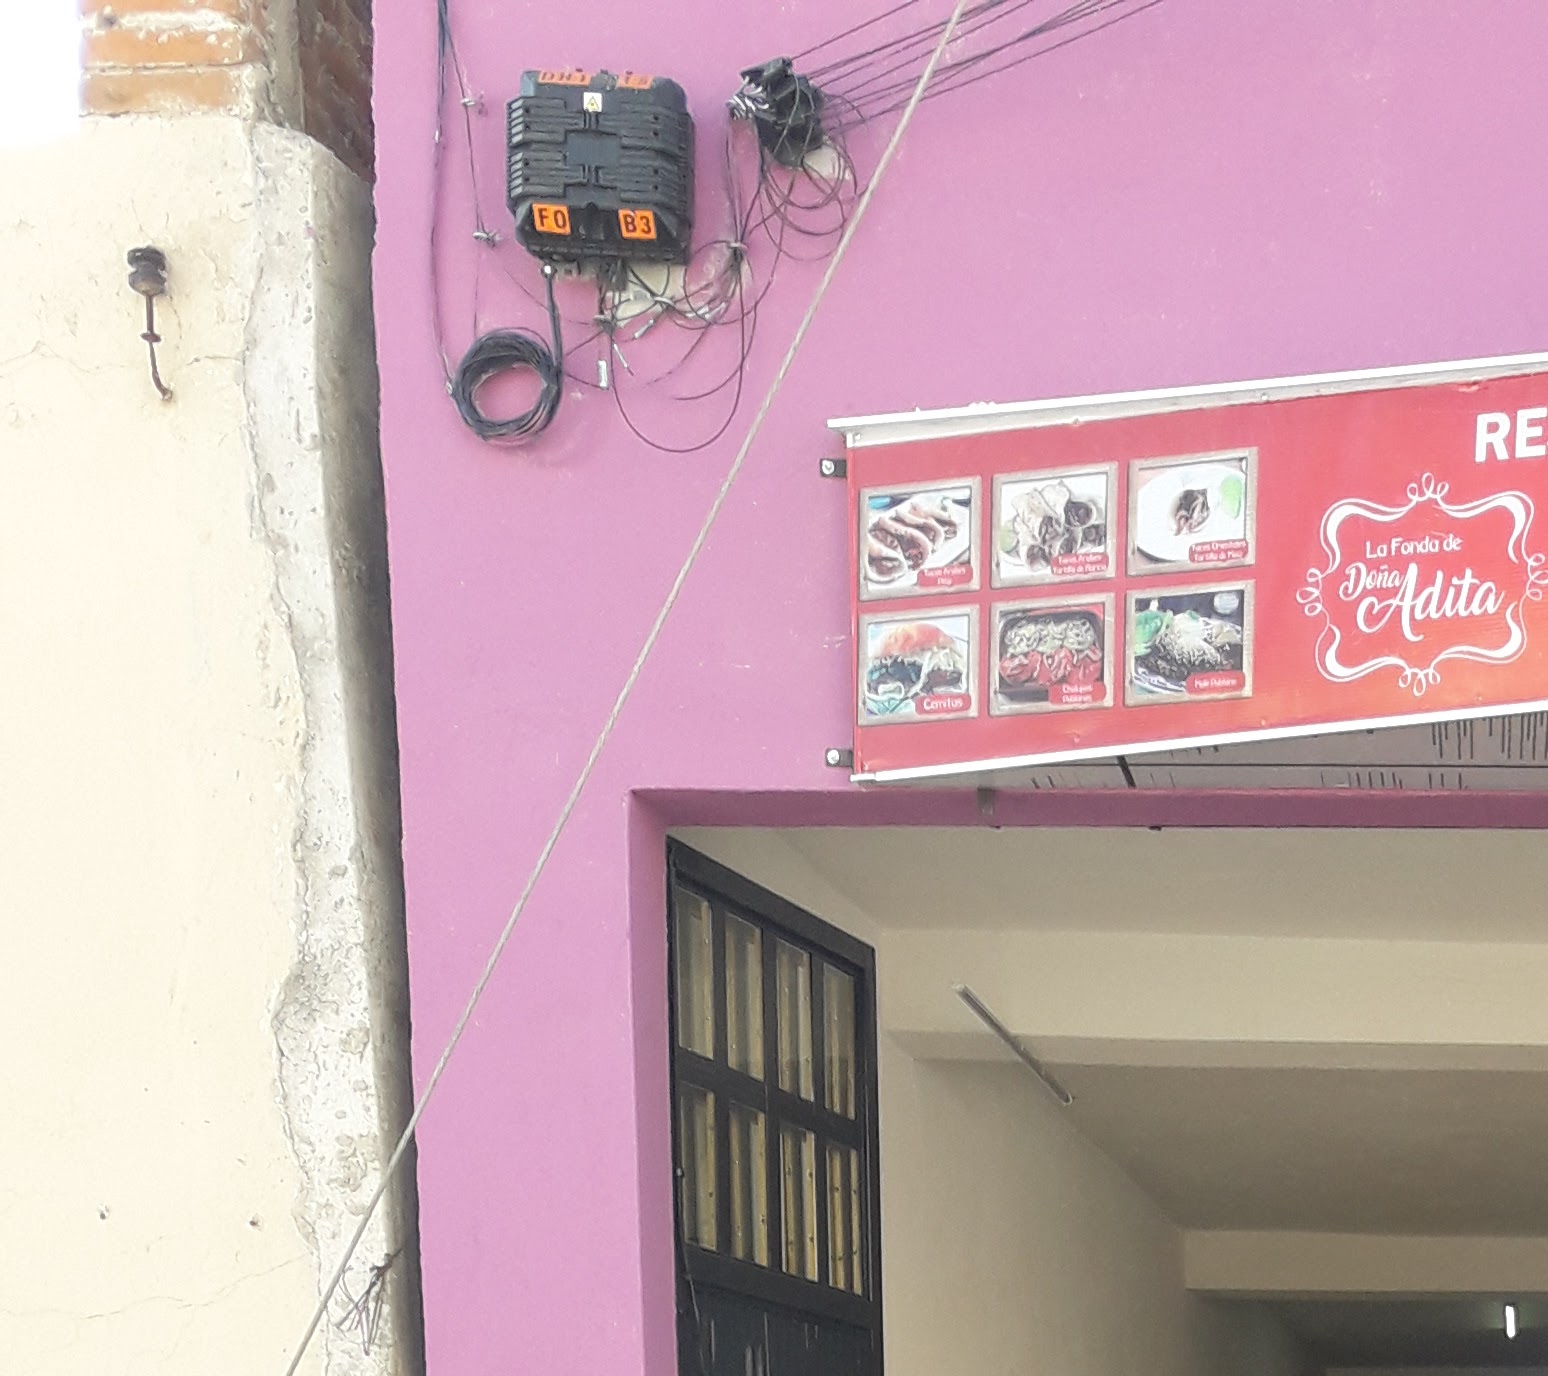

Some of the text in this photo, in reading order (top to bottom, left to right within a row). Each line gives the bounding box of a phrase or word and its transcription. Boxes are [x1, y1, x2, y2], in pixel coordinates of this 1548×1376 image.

[623, 213, 652, 234] B3
[1366, 533, 1464, 559] La Fonda de
[1339, 562, 1504, 641] Doña Adita
